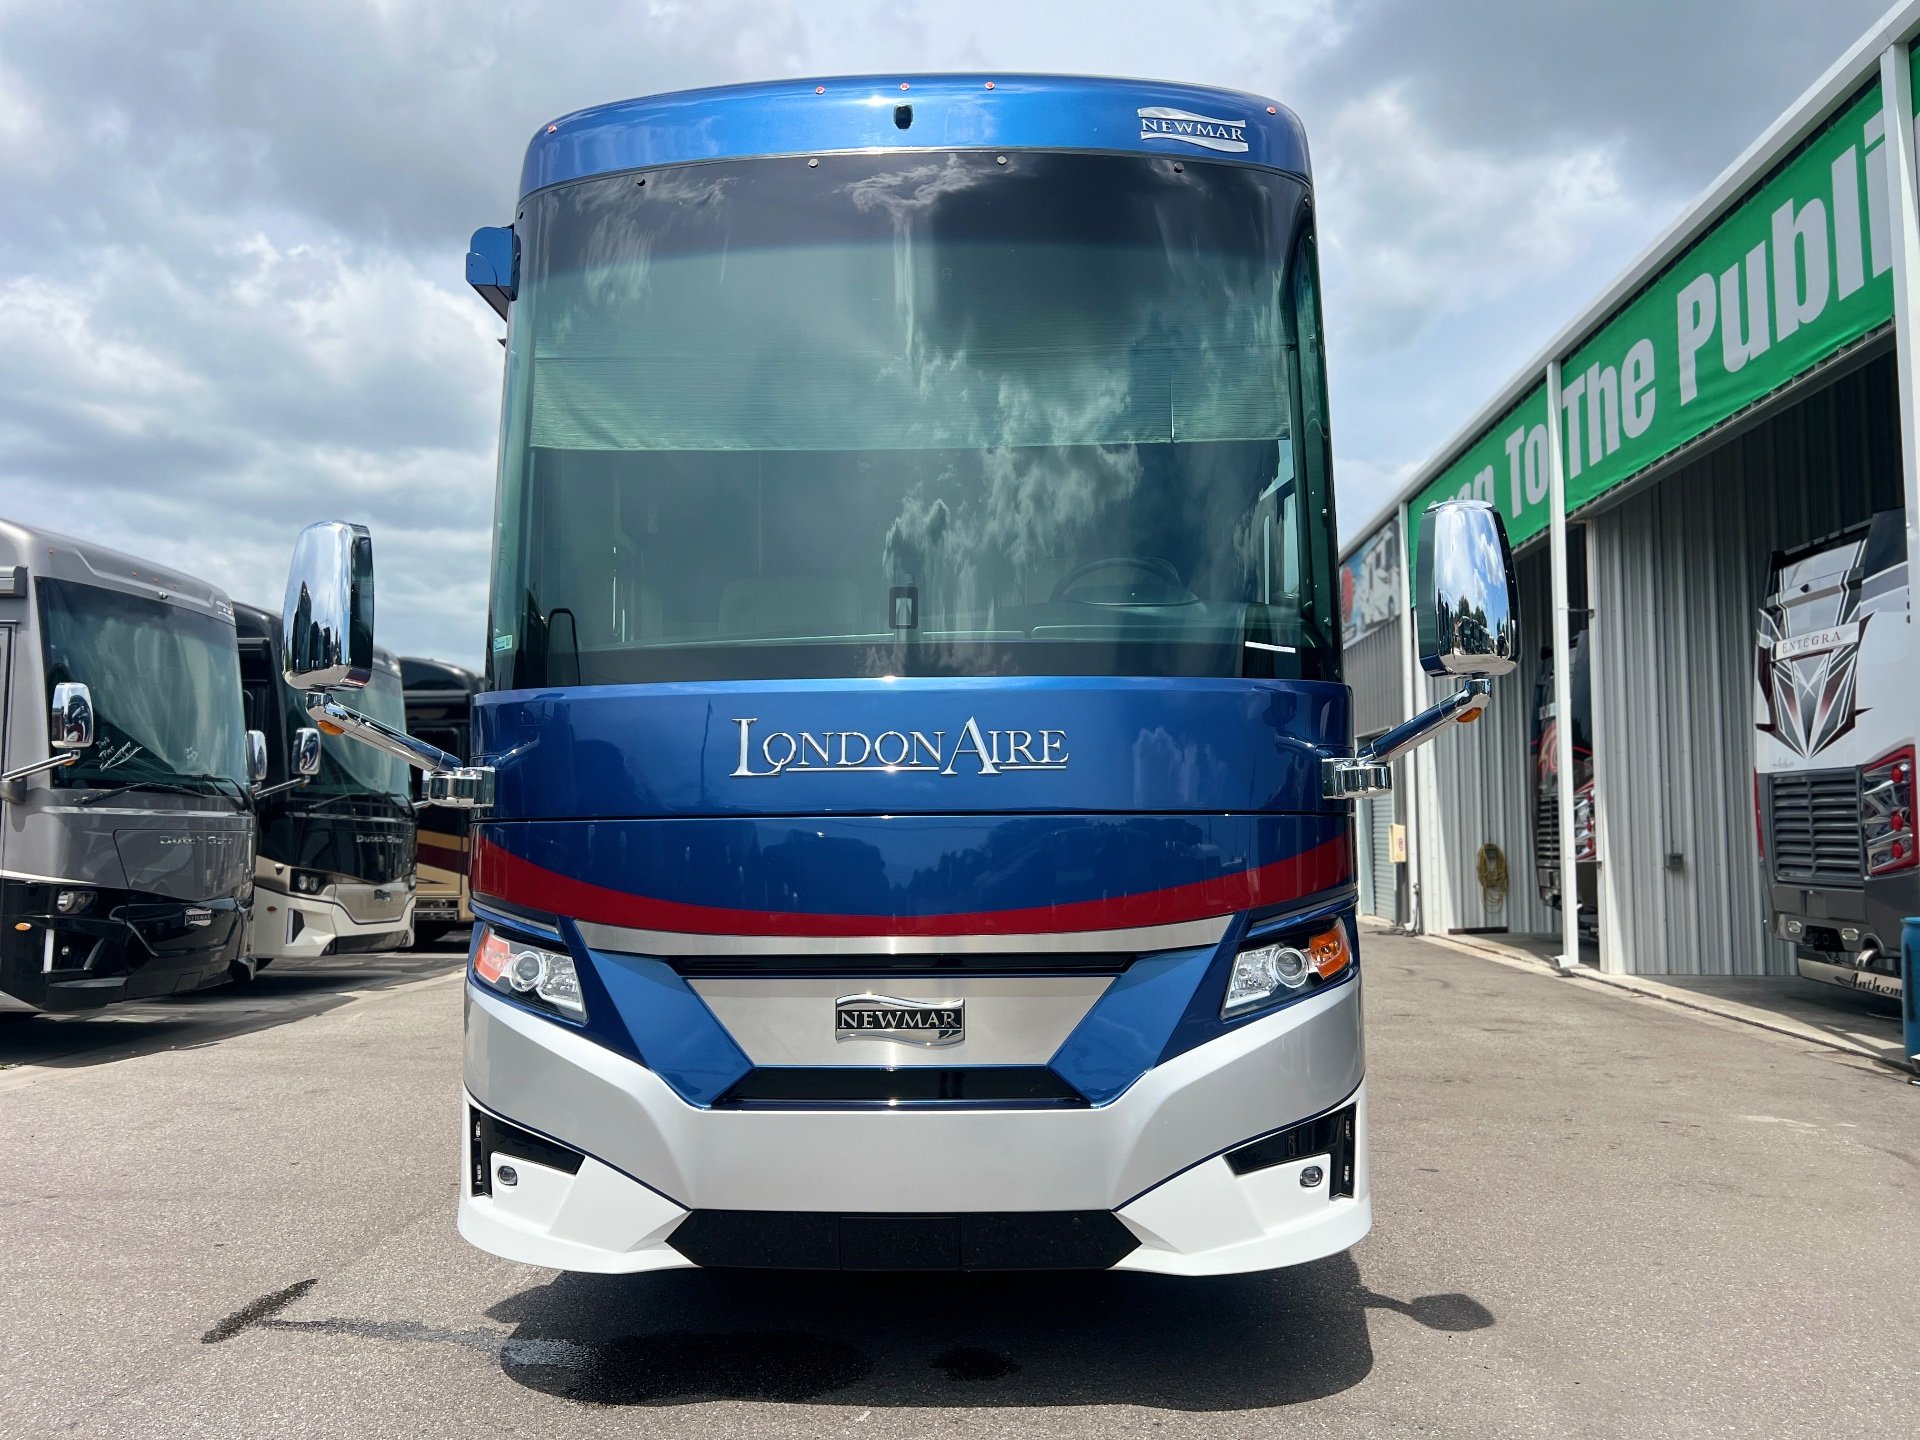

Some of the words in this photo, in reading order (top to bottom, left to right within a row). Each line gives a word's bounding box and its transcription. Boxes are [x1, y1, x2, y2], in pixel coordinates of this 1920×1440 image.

[1141, 118, 1246, 141] NEWMAR
[1505, 423, 1549, 519] To
[1561, 338, 1656, 481] The
[1676, 108, 1920, 407] Publi
[1782, 631, 1841, 654] ENTEGRA
[1833, 972, 1904, 997] Anthem
[839, 1011, 960, 1029] NEWMAR
